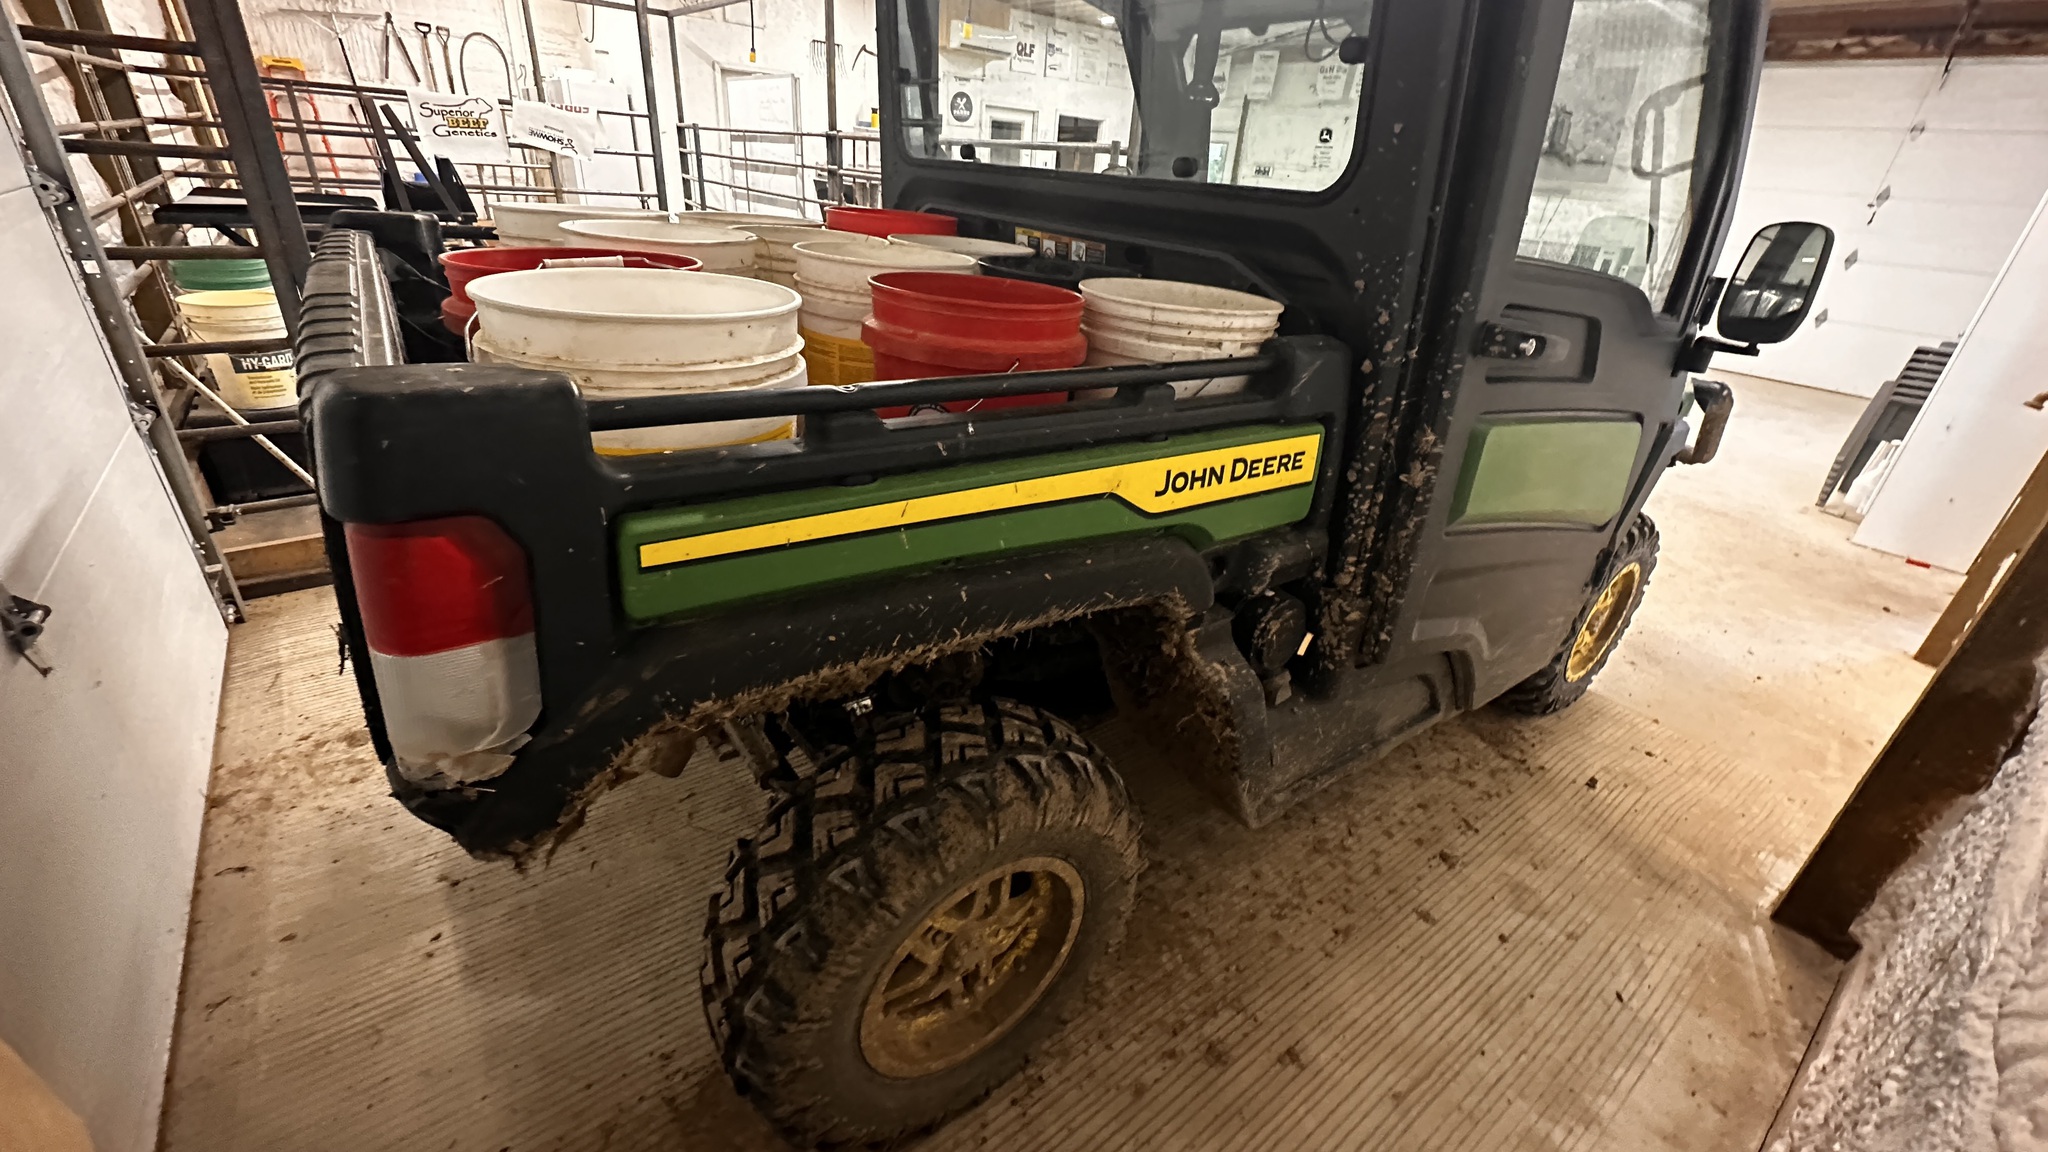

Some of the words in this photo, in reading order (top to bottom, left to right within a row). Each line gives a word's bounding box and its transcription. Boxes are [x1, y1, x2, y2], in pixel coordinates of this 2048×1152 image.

[419, 102, 474, 121] Superior
[432, 124, 498, 137] Genetics
[1154, 464, 1226, 497] JOHN
[1229, 450, 1306, 483] DEERE
